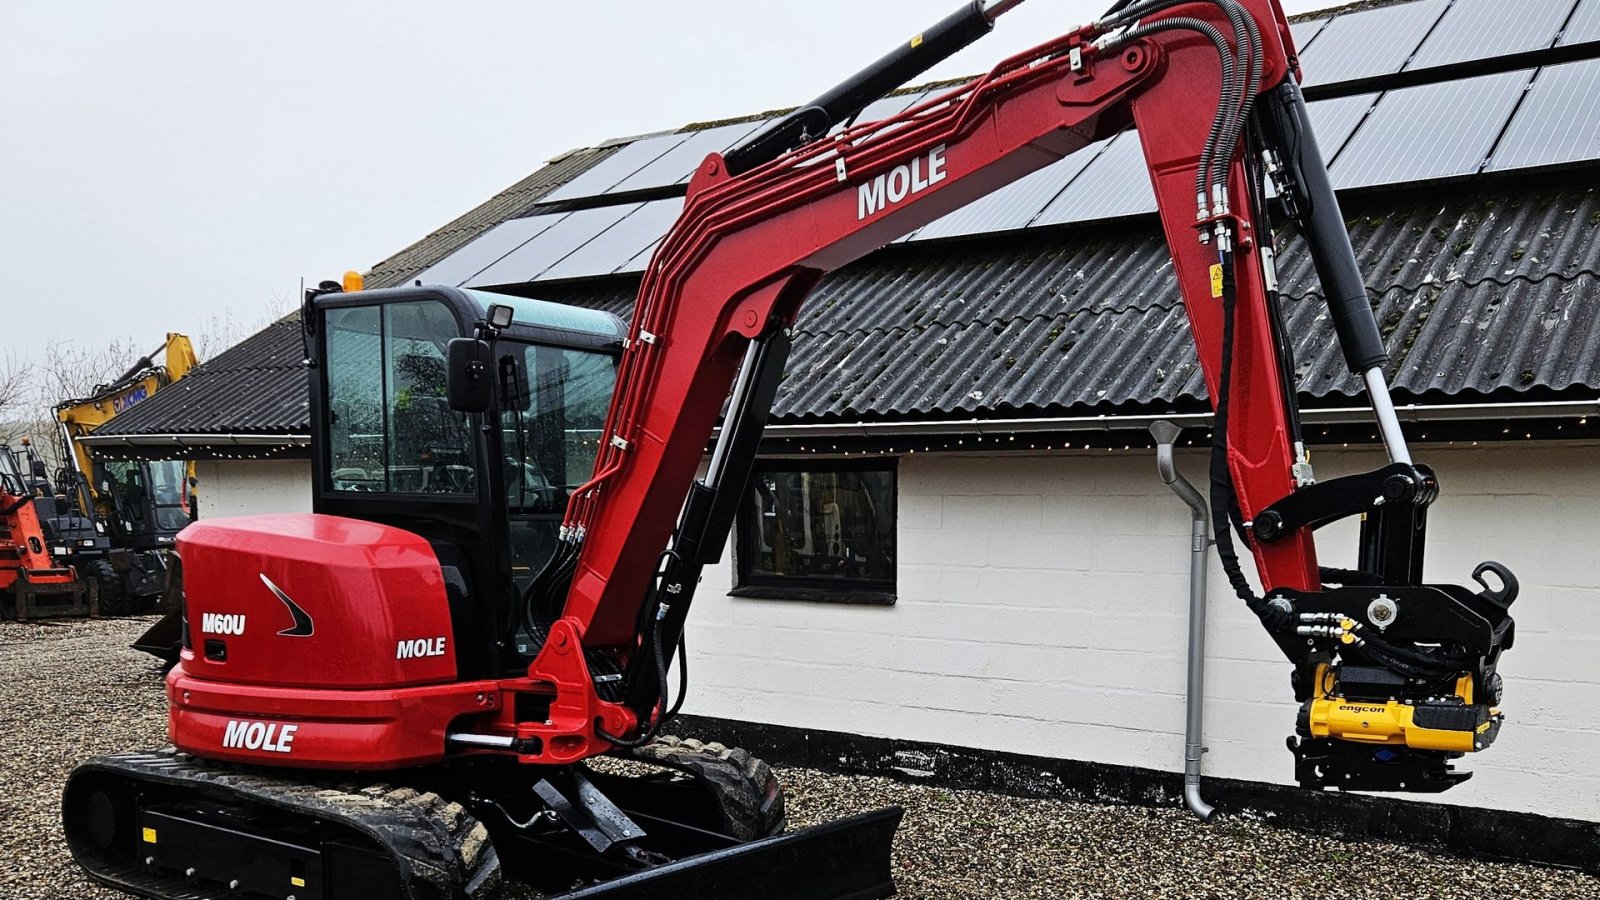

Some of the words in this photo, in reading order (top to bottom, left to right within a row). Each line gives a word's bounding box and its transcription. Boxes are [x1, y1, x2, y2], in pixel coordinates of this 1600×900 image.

[857, 144, 947, 220] MOLE
[122, 387, 147, 409] XCMG
[202, 613, 246, 635] M60U
[397, 637, 446, 659] MOLE
[1339, 704, 1386, 714] engcon
[223, 720, 298, 753] MOLE
